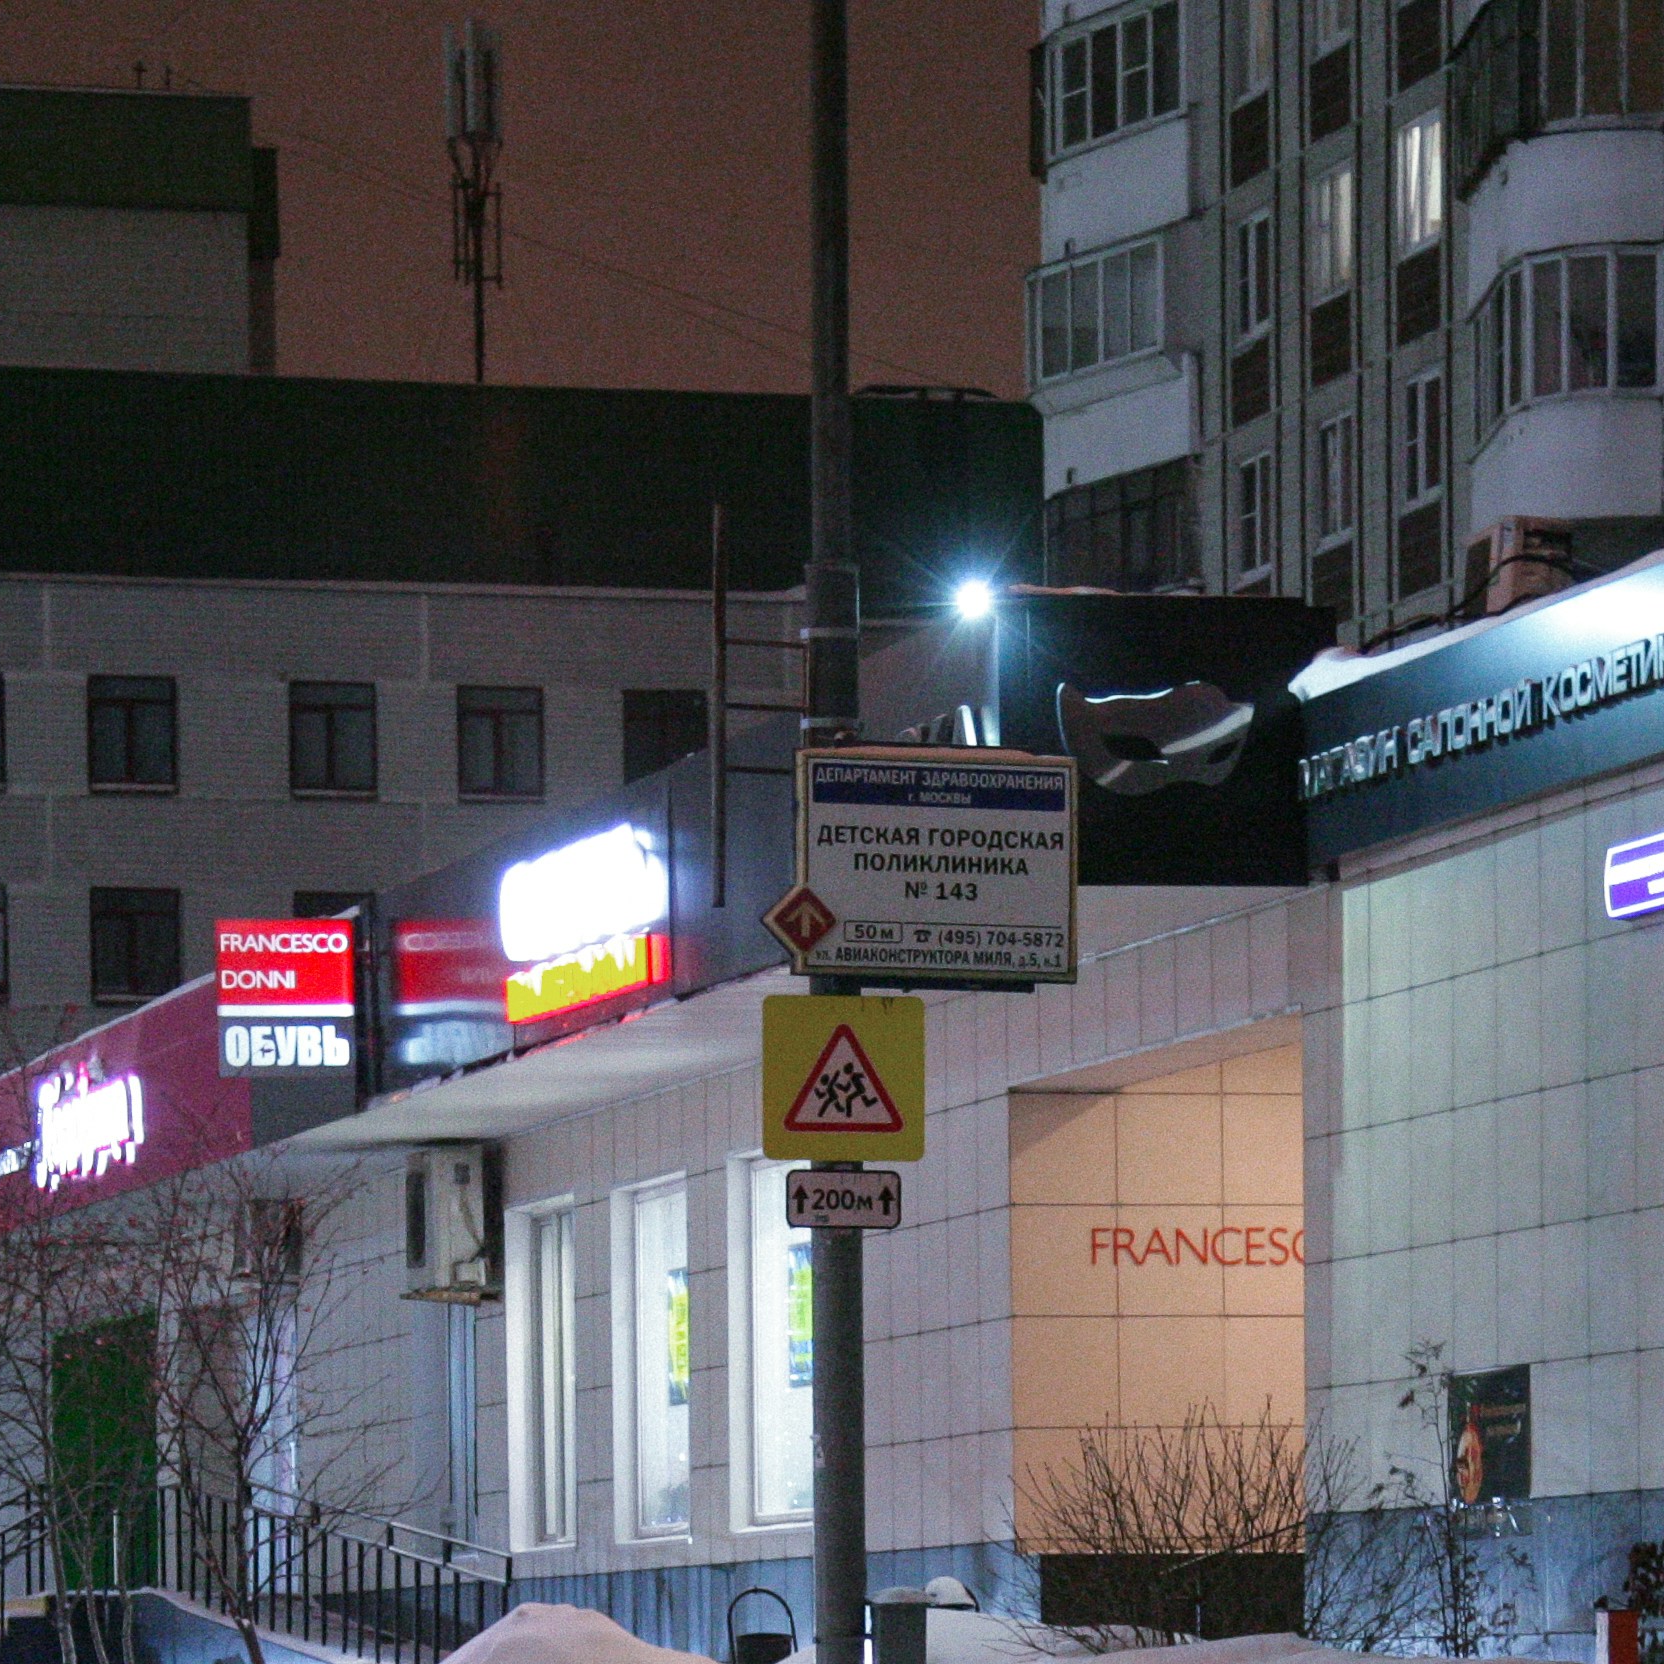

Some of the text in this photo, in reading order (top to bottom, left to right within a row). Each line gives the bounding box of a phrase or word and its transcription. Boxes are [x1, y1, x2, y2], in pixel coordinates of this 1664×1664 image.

[1405, 683, 1534, 767] САЛОННОЙ
[815, 767, 1064, 791] ДЕПАРТАМЕНТ ЗДРАВООХРАНЕНИЯ
[919, 792, 972, 804] МОСКВЫ
[817, 825, 1065, 851] ДЕТСКАЯ ГОРОДСКАЯ
[854, 853, 1029, 876] ПОЛИКЛИНИКА
[904, 881, 978, 901] № 143
[854, 924, 877, 939] 50
[938, 929, 1064, 948] (495) 704-5872
[220, 932, 348, 954] FRANCESCO
[837, 947, 970, 965] АВИАКОНСТРУКТОРА
[973, 950, 1015, 967] МИЛЯ,
[221, 970, 296, 990] DONNI
[224, 1025, 350, 1068] ОБУВЬ
